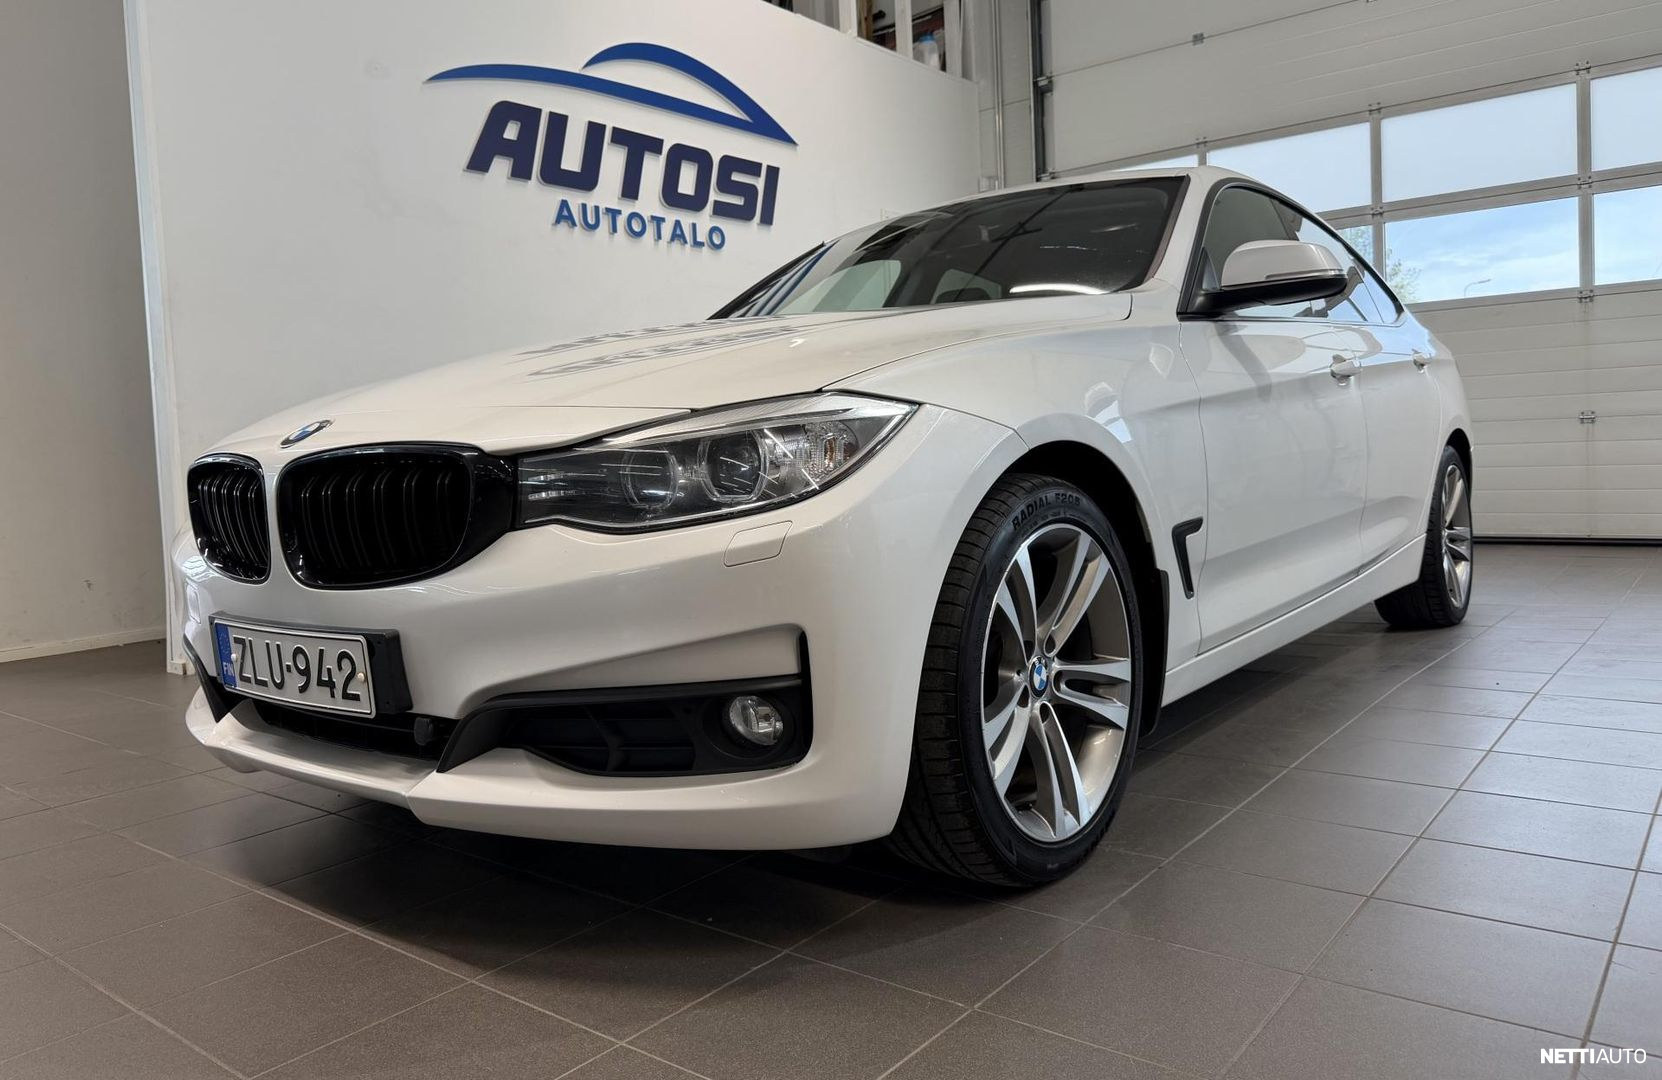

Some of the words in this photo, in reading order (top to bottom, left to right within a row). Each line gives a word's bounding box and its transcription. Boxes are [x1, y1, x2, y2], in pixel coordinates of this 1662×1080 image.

[465, 100, 780, 226] AUTOSI
[552, 199, 726, 251] AUTOTALO
[1013, 496, 1051, 530] RADIAL
[223, 661, 235, 677] FIN
[233, 636, 361, 702] ZLU-942
